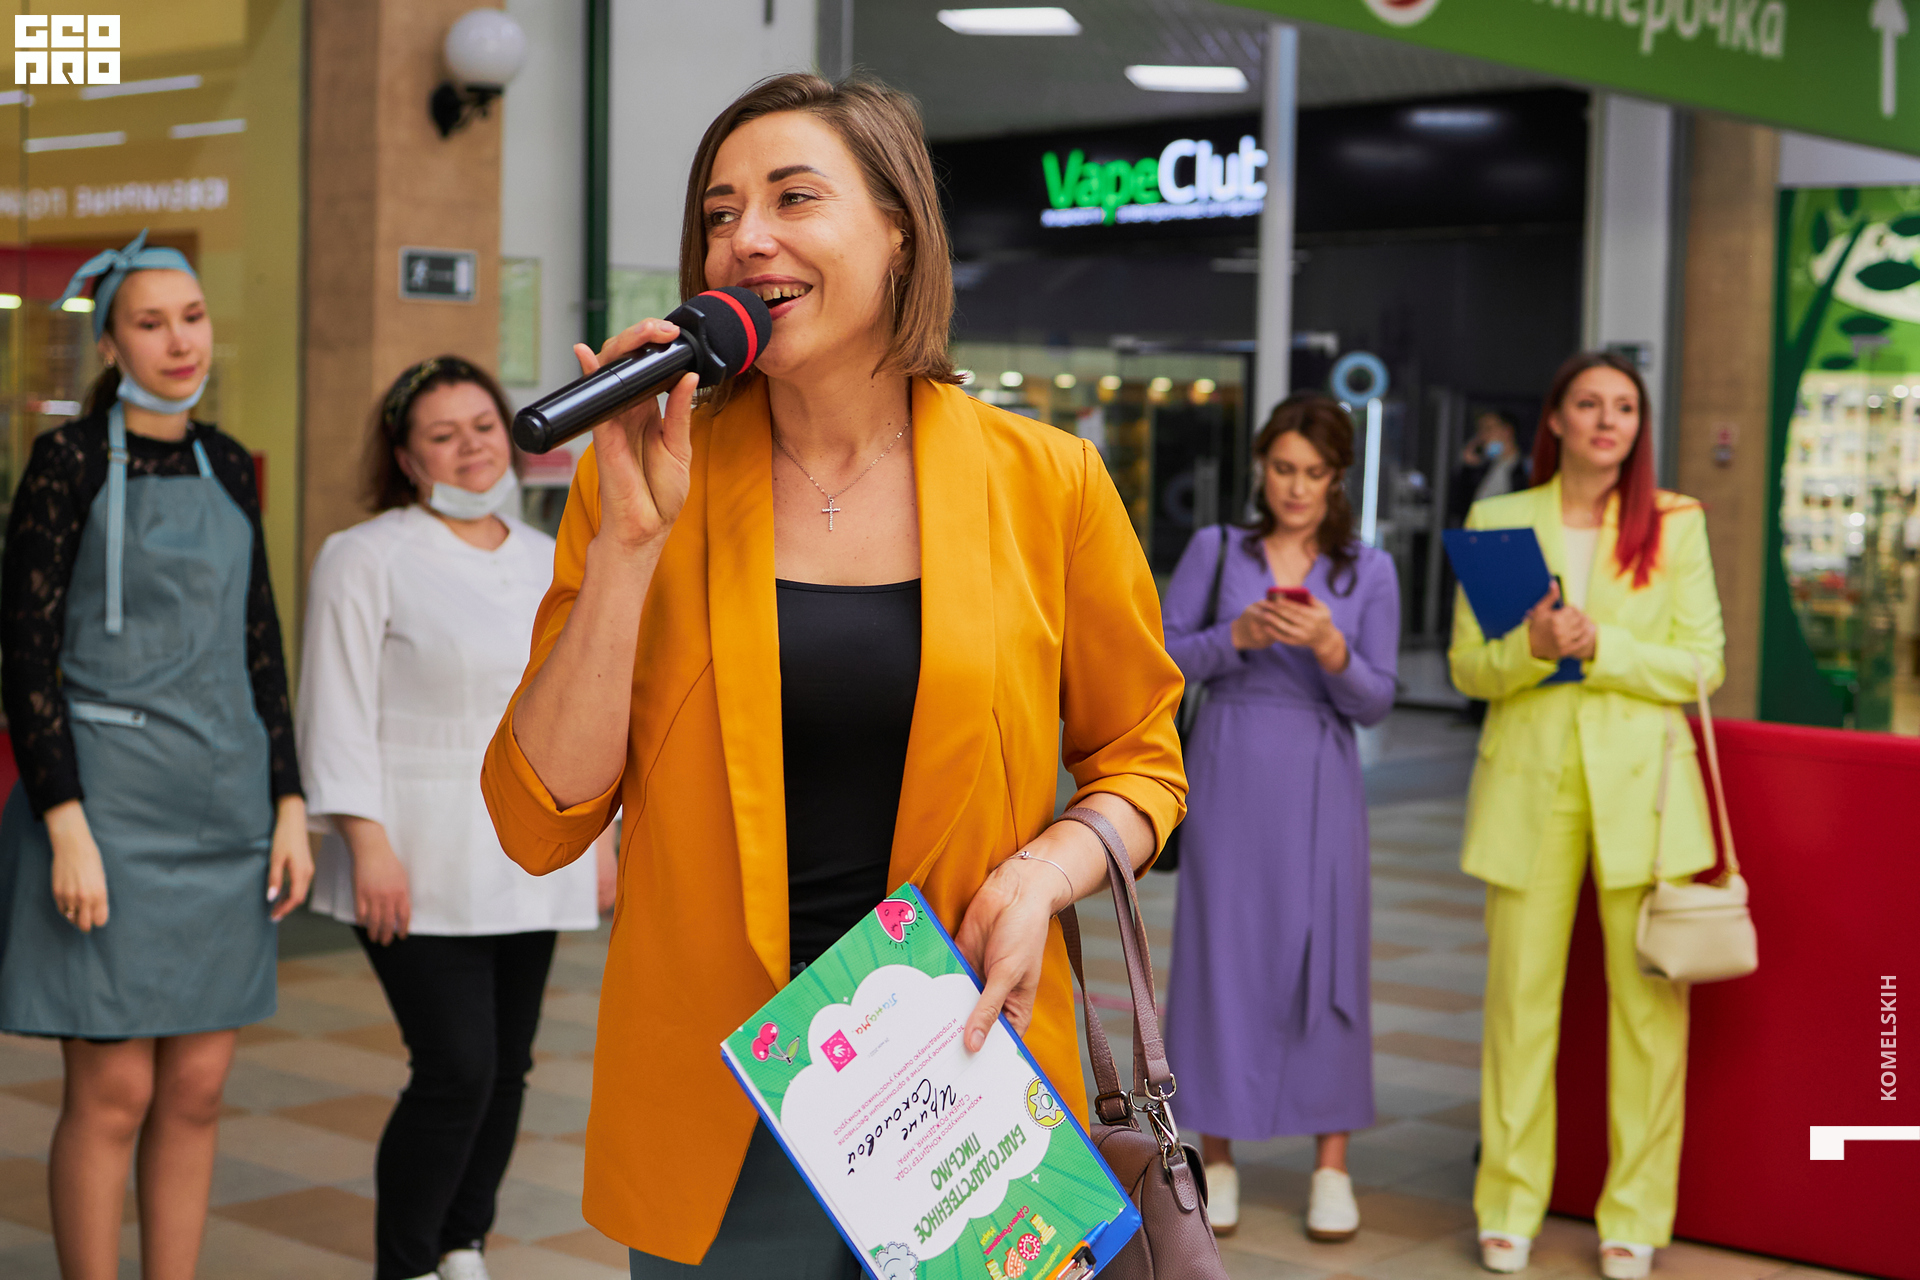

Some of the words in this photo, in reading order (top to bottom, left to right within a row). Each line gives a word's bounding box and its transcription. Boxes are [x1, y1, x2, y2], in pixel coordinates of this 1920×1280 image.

[913, 1022, 953, 1061] справедливую
[931, 1031, 958, 1057] активное
[893, 1059, 914, 1080] оценку
[909, 1053, 933, 1078] участие
[860, 1076, 894, 1110] участников
[868, 1080, 906, 1117] организации
[947, 1097, 966, 1118] ДНЕМ
[966, 1094, 983, 1112] жюри
[833, 1108, 862, 1136] конкурса
[848, 1078, 931, 1175] Соколовой
[901, 1085, 956, 1141] Ирине
[940, 1109, 968, 1137] конкурса
[837, 1115, 870, 1146] фестиваля
[896, 1146, 916, 1167] МИРА!
[911, 1134, 943, 1167] КОНДИТЕР
[930, 1131, 982, 1192] ПИСЬМО
[912, 1123, 1027, 1246] БЛАГОДАРСТВЕННОЕ
